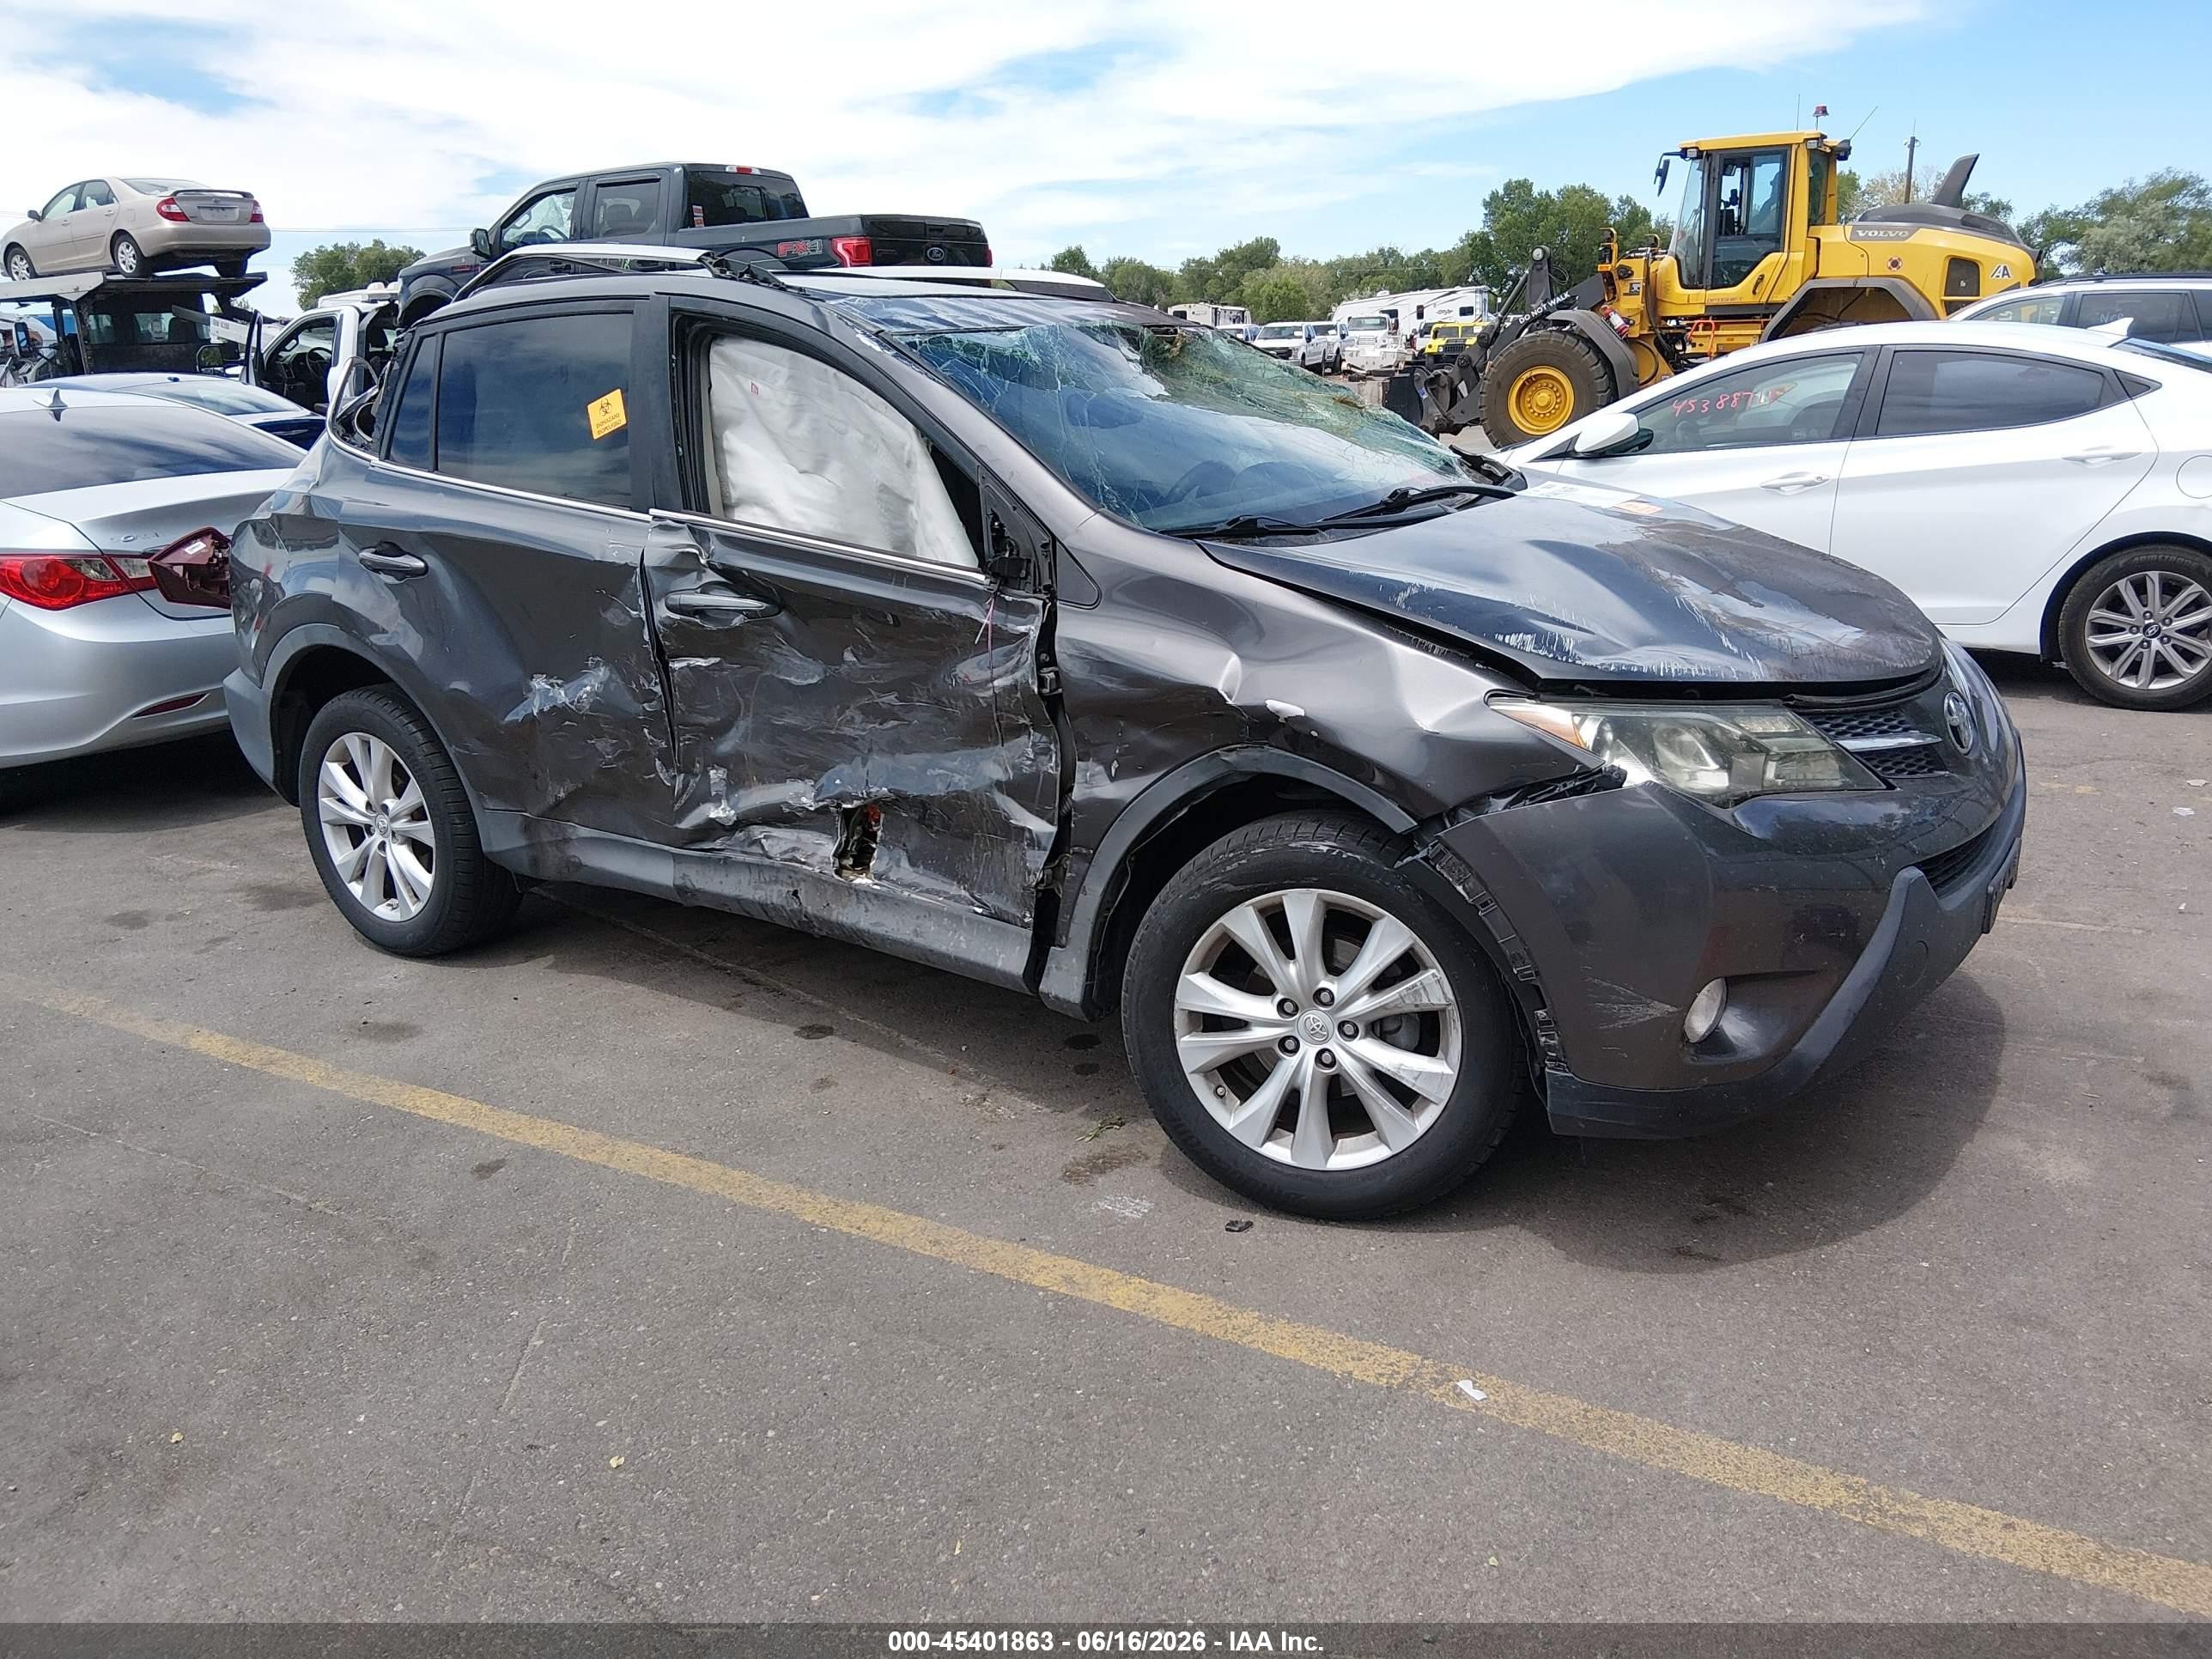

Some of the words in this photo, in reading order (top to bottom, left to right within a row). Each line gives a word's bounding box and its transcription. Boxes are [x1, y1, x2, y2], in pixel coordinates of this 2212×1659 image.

[778, 240, 823, 257] FX4
[1519, 314, 1530, 325] DO
[1531, 303, 1547, 317] NOT
[1547, 291, 1571, 307] WALK
